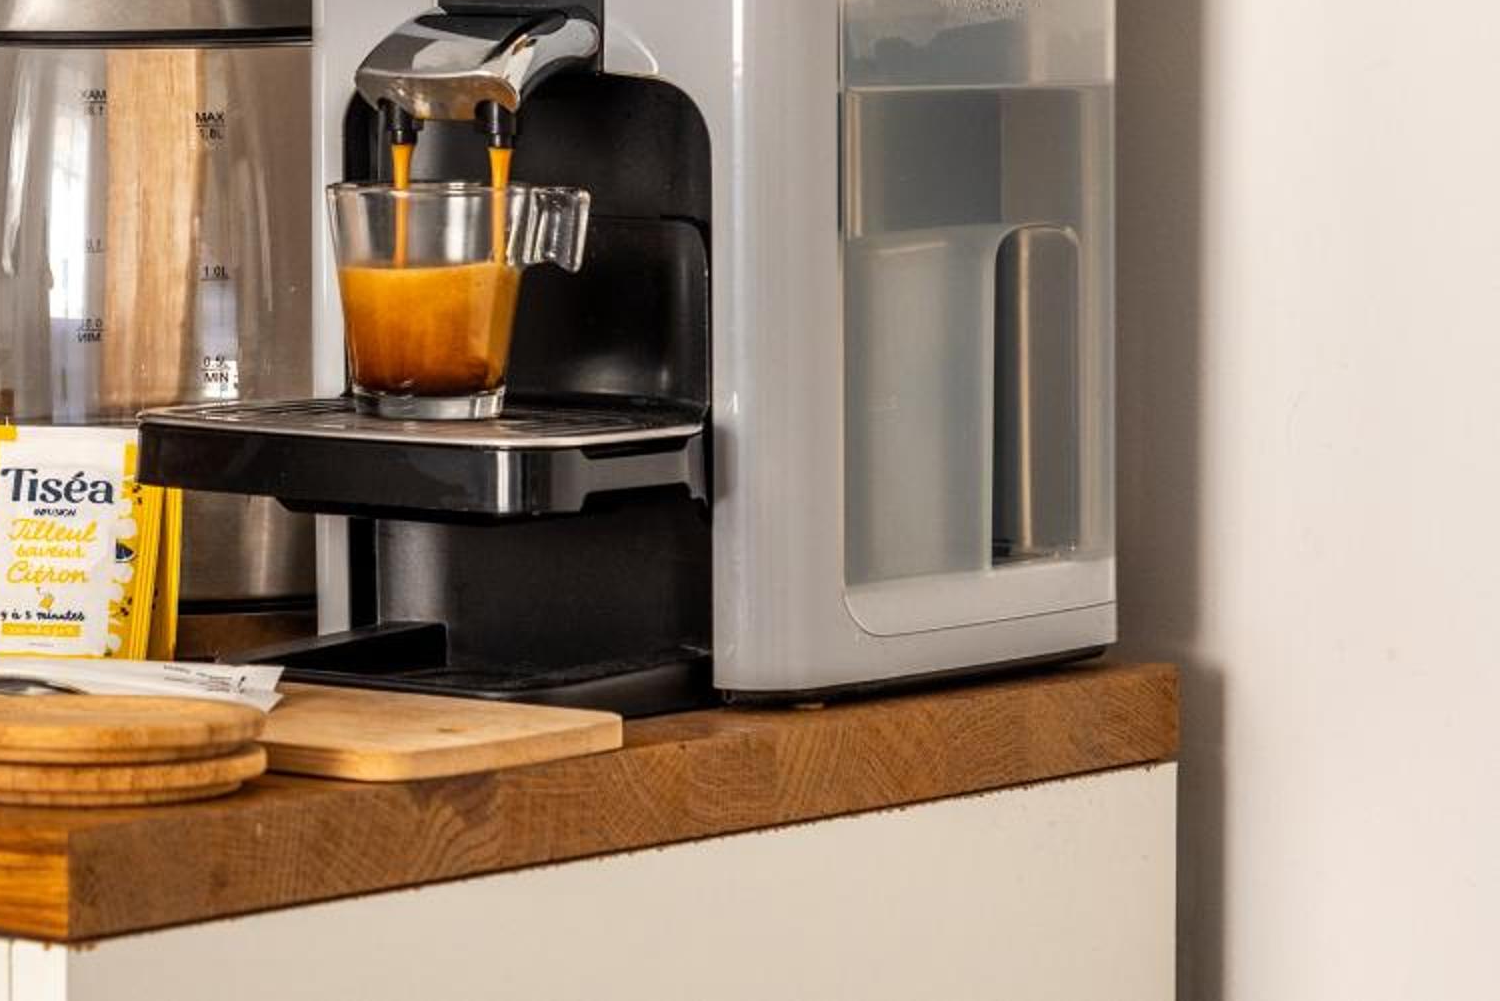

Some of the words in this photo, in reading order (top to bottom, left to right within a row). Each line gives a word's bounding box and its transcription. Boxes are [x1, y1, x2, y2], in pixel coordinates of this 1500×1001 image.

[195, 111, 225, 124] MAX
[203, 372, 229, 383] MIN
[0, 468, 114, 505] Tiséa
[8, 518, 97, 543] Tilleul
[6, 559, 88, 584] Citron
[36, 610, 84, 621] minutes
